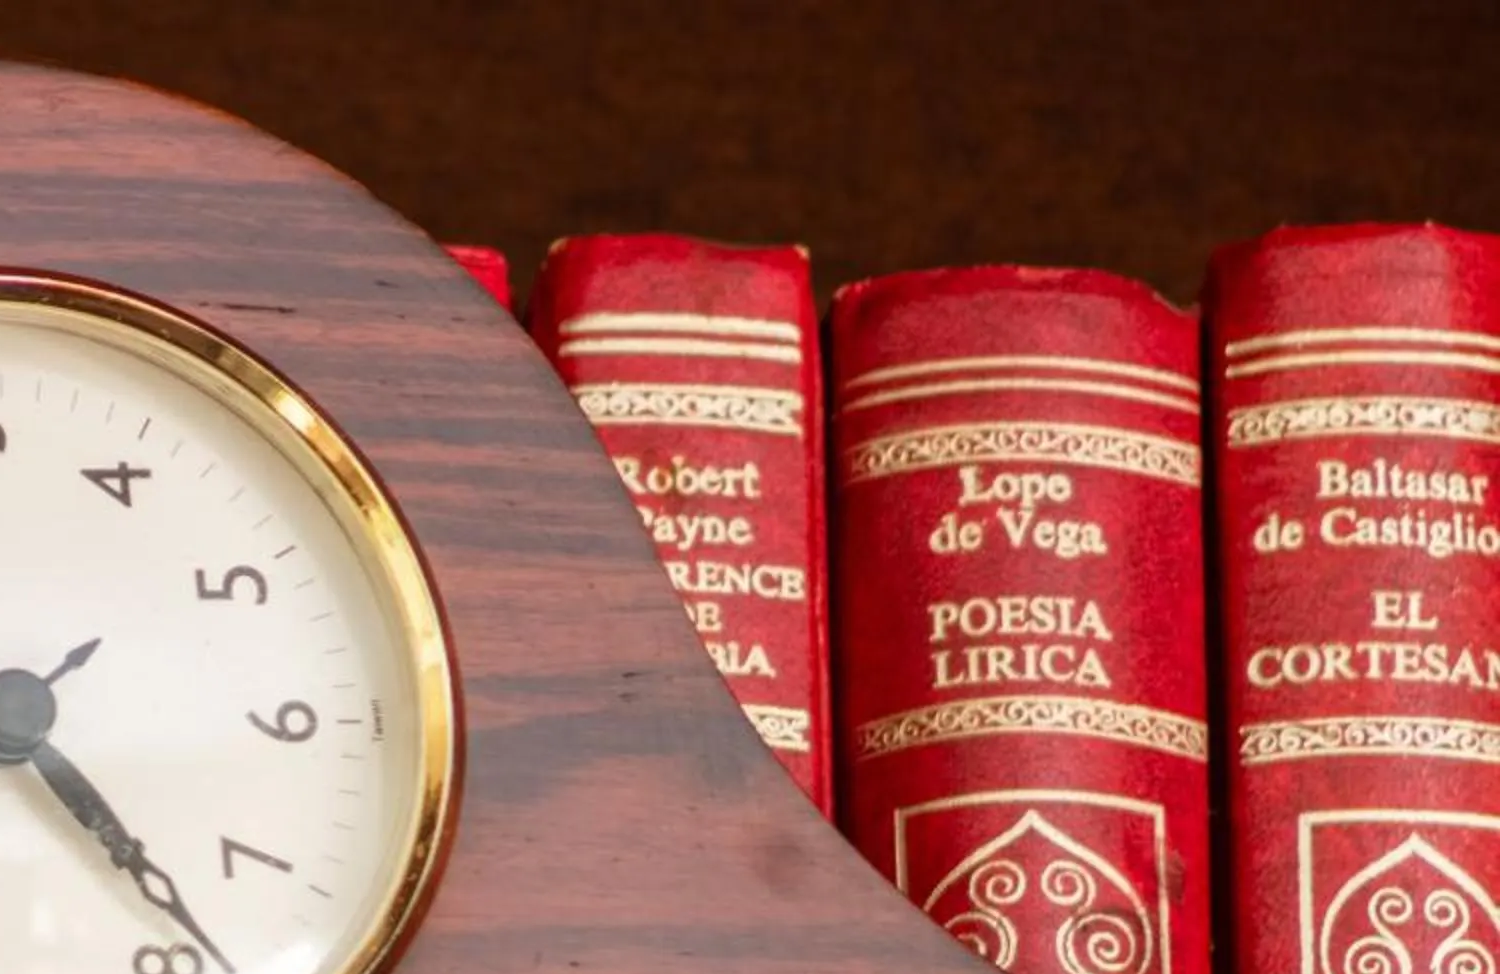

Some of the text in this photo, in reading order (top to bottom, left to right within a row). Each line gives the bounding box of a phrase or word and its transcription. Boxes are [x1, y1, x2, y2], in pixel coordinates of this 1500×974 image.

[80, 461, 151, 508] 4
[612, 454, 762, 498] Robert
[956, 465, 1073, 510] Lope
[1315, 456, 1489, 506] Baltasar
[928, 506, 1110, 559] de Vega
[1252, 510, 1306, 555] de
[195, 565, 268, 605] 5
[664, 560, 806, 601] RENCE
[683, 600, 723, 633] E
[926, 596, 1114, 641] POESIA
[1370, 588, 1440, 630] EL
[930, 644, 1112, 688] LIRICA
[247, 701, 318, 743] 6
[220, 836, 293, 879] 7
